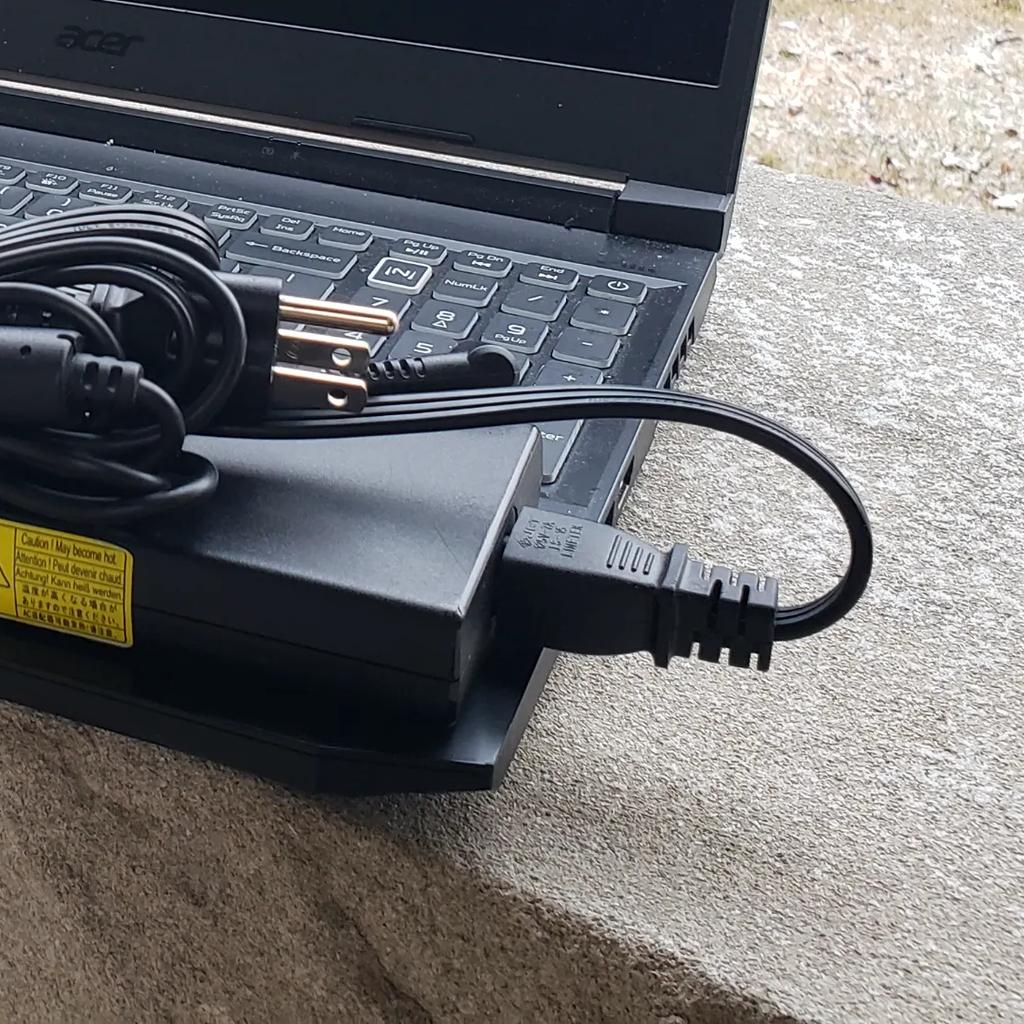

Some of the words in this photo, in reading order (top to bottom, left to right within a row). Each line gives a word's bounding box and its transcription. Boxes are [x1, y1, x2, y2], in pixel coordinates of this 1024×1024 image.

[57, 25, 144, 56] acer
[46, 173, 67, 181] F10
[100, 183, 118, 191] F11
[87, 188, 118, 198] Pause
[154, 192, 176, 201] F12
[217, 205, 251, 215] PrtSc
[211, 211, 245, 223] SysRq
[281, 217, 300, 225] Del
[275, 224, 294, 232] Ins
[332, 226, 365, 236] Home
[404, 239, 420, 247] Pg
[271, 245, 341, 263] Backspace
[467, 252, 484, 260] Pg
[487, 255, 504, 263] Dn
[540, 265, 565, 274] End
[444, 279, 488, 292] NumLk
[371, 296, 389, 306] 7
[436, 310, 455, 321] 8
[507, 324, 526, 336] 9
[414, 342, 434, 354] 5
[21, 532, 49, 550] Caution
[56, 539, 71, 557] May
[72, 544, 102, 561] become
[16, 551, 47, 568] Attention
[53, 559, 70, 574] Peut
[71, 562, 97, 579] devenir
[98, 568, 122, 585] chaud
[51, 576, 72, 589] Kann
[92, 587, 122, 601] werden
